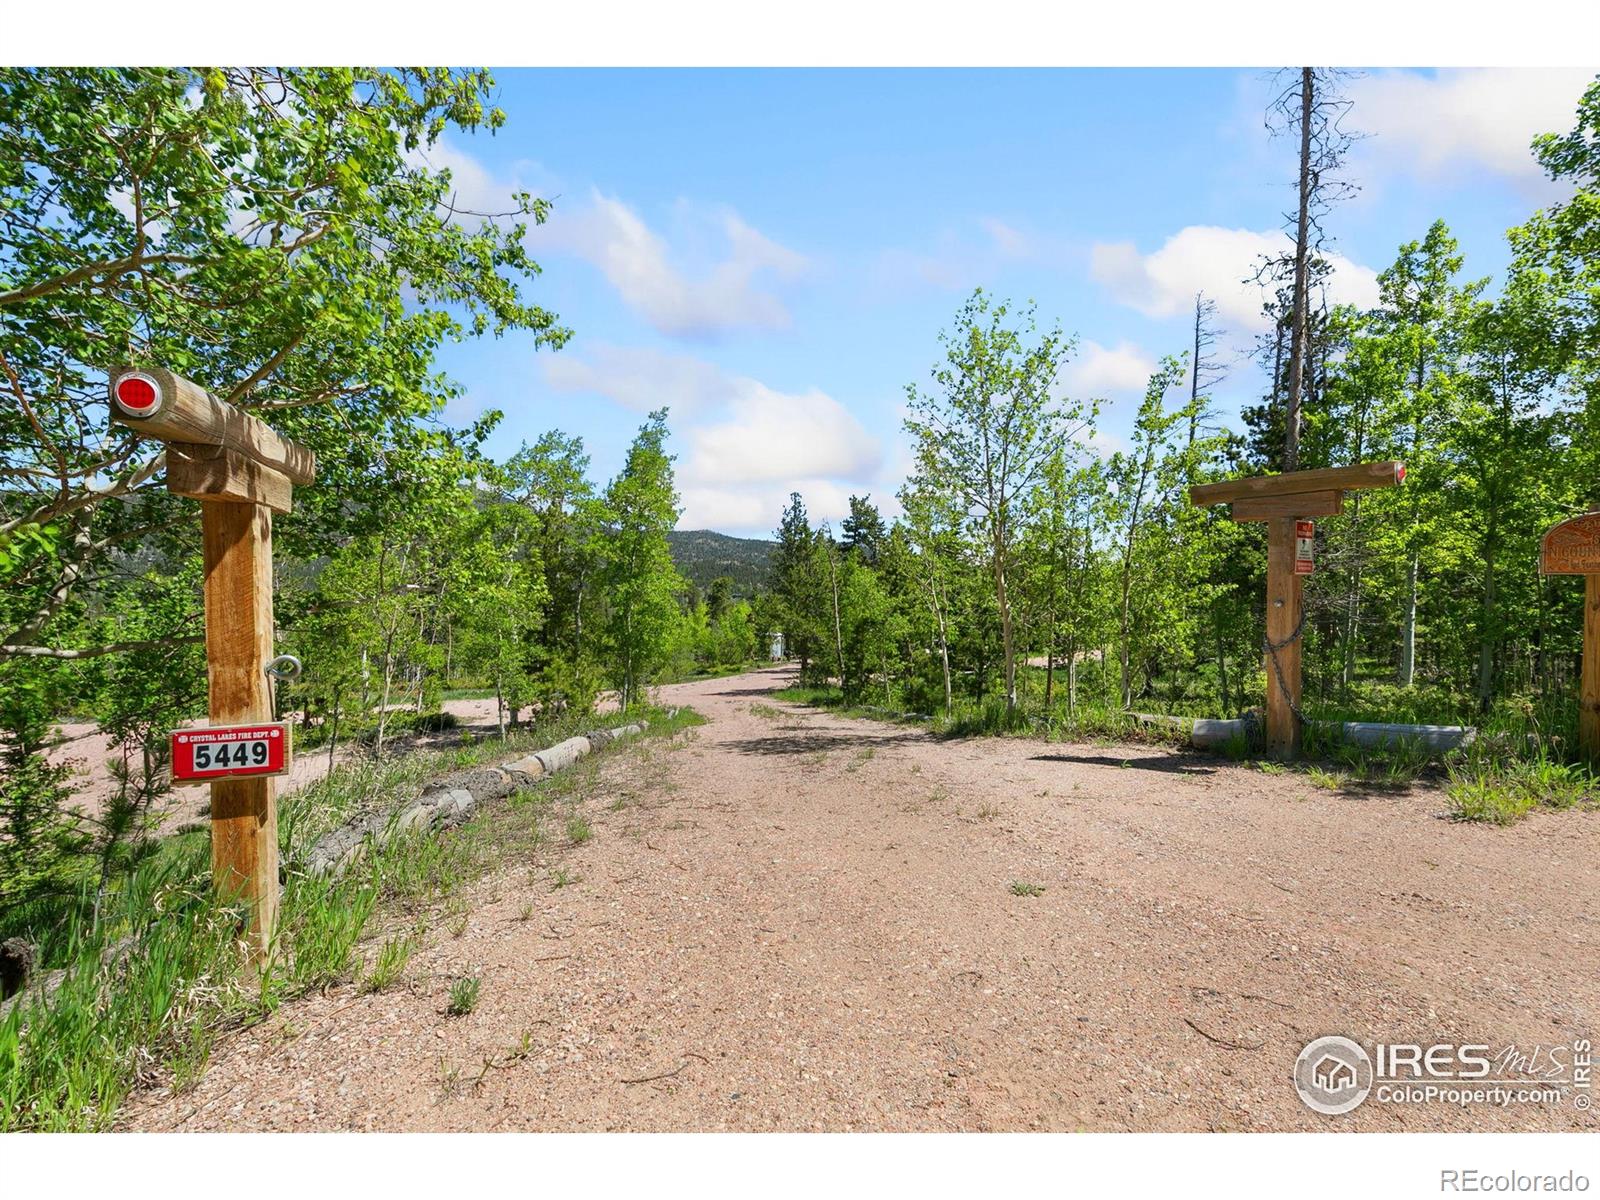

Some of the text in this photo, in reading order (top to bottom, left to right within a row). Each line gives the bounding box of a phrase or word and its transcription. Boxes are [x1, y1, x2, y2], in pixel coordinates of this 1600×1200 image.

[189, 734, 216, 743] CRYSTAL
[218, 732, 237, 741] LAKES
[238, 731, 252, 740] FIRE
[195, 741, 268, 769] 5449
